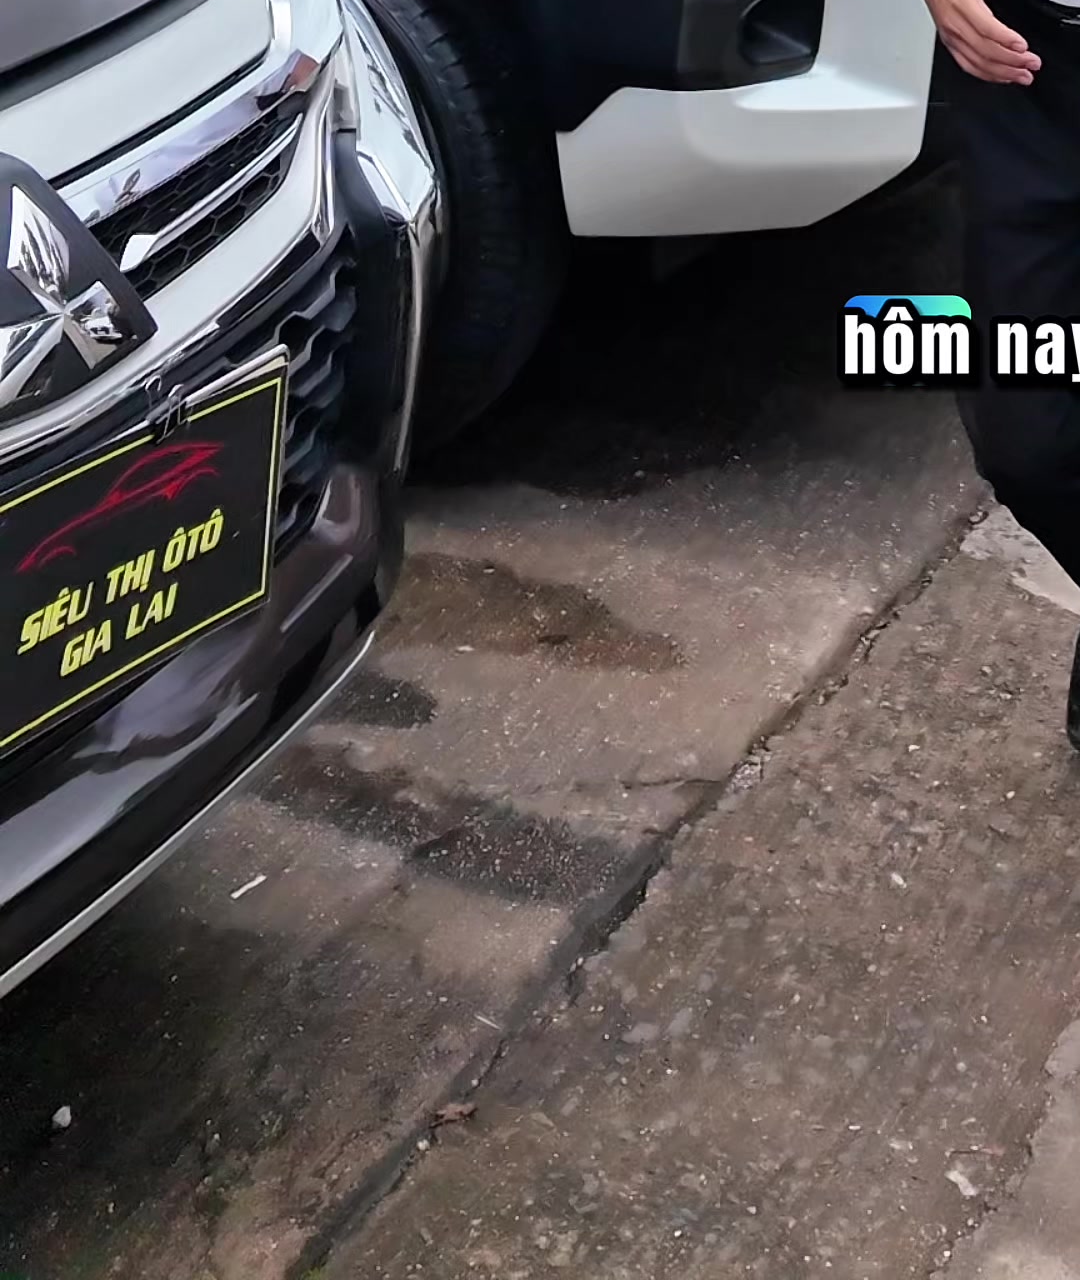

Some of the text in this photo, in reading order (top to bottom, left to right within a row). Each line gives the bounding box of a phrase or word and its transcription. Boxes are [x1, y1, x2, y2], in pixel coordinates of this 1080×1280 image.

[17, 508, 225, 655] SIÊU THỊ ÔTÔ
[60, 582, 179, 678] GIA LAI
